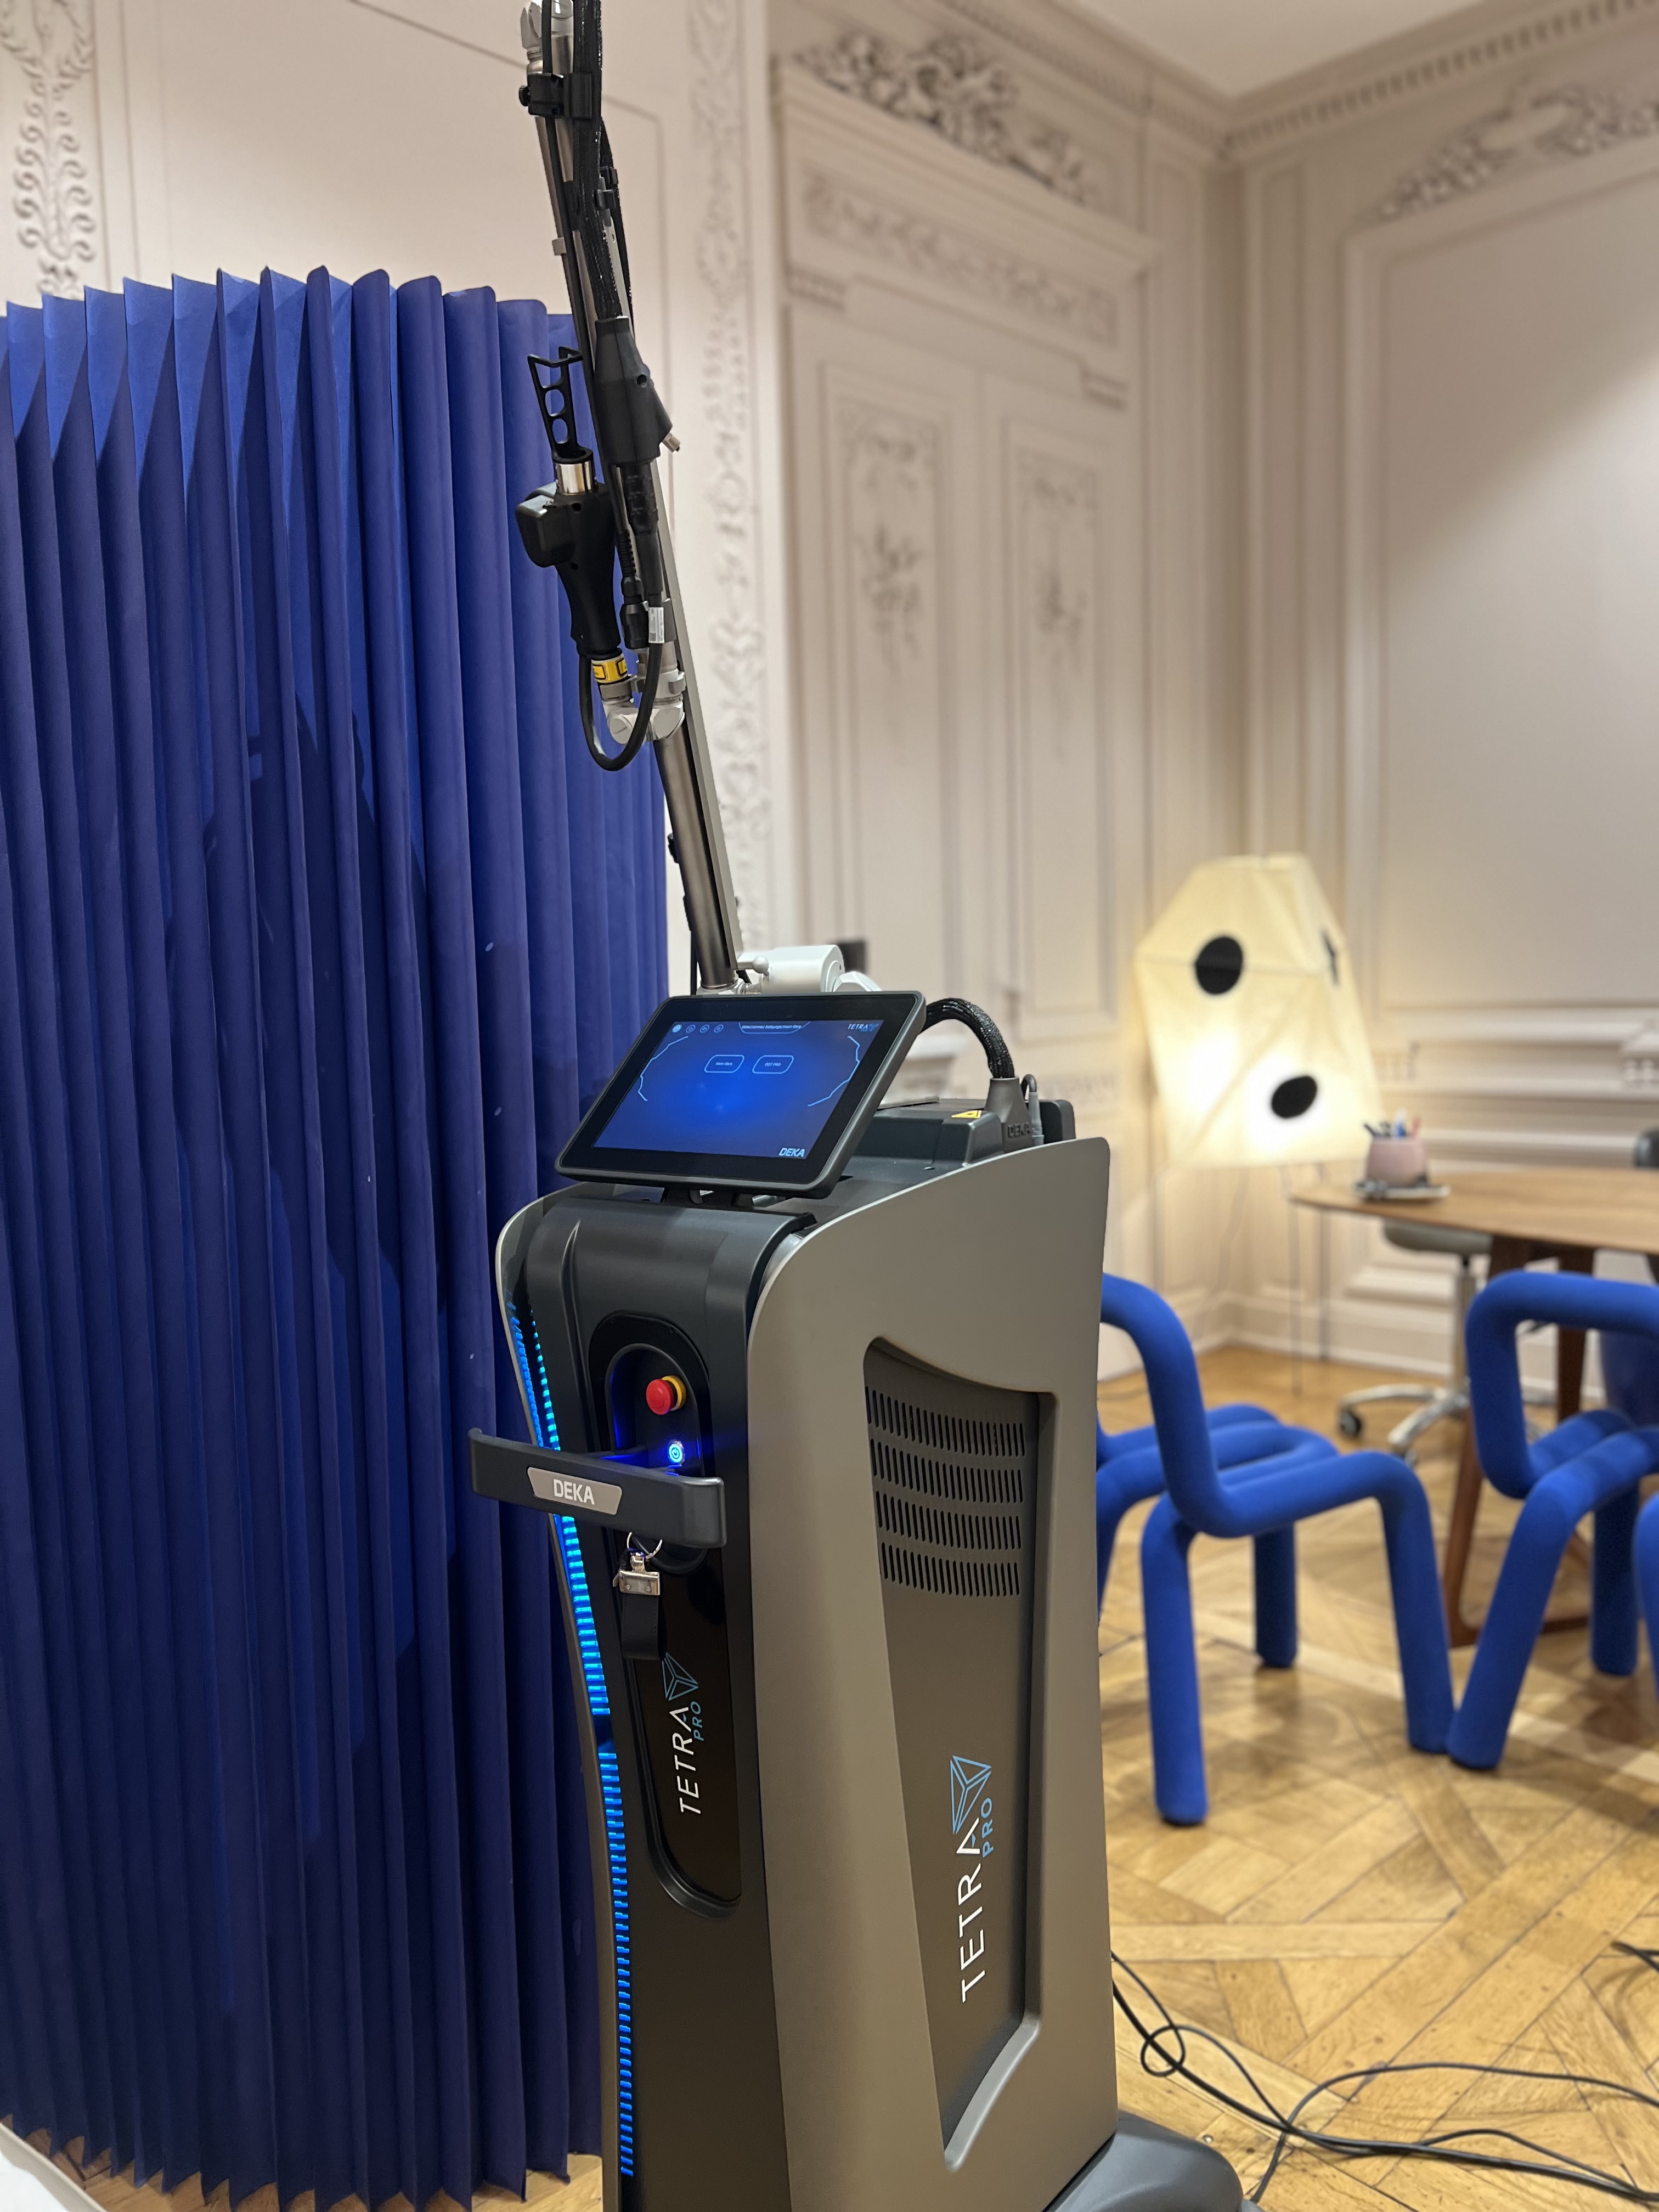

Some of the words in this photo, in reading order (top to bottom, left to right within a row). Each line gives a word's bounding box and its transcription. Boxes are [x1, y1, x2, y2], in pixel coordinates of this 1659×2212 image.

[778, 1147, 805, 1157] DEKA
[553, 1479, 595, 1505] DEKA
[691, 1701, 704, 1741] PRO
[669, 1707, 701, 1814] TETRA
[981, 1797, 994, 1858] PRO
[956, 1817, 985, 2003] TETRA
